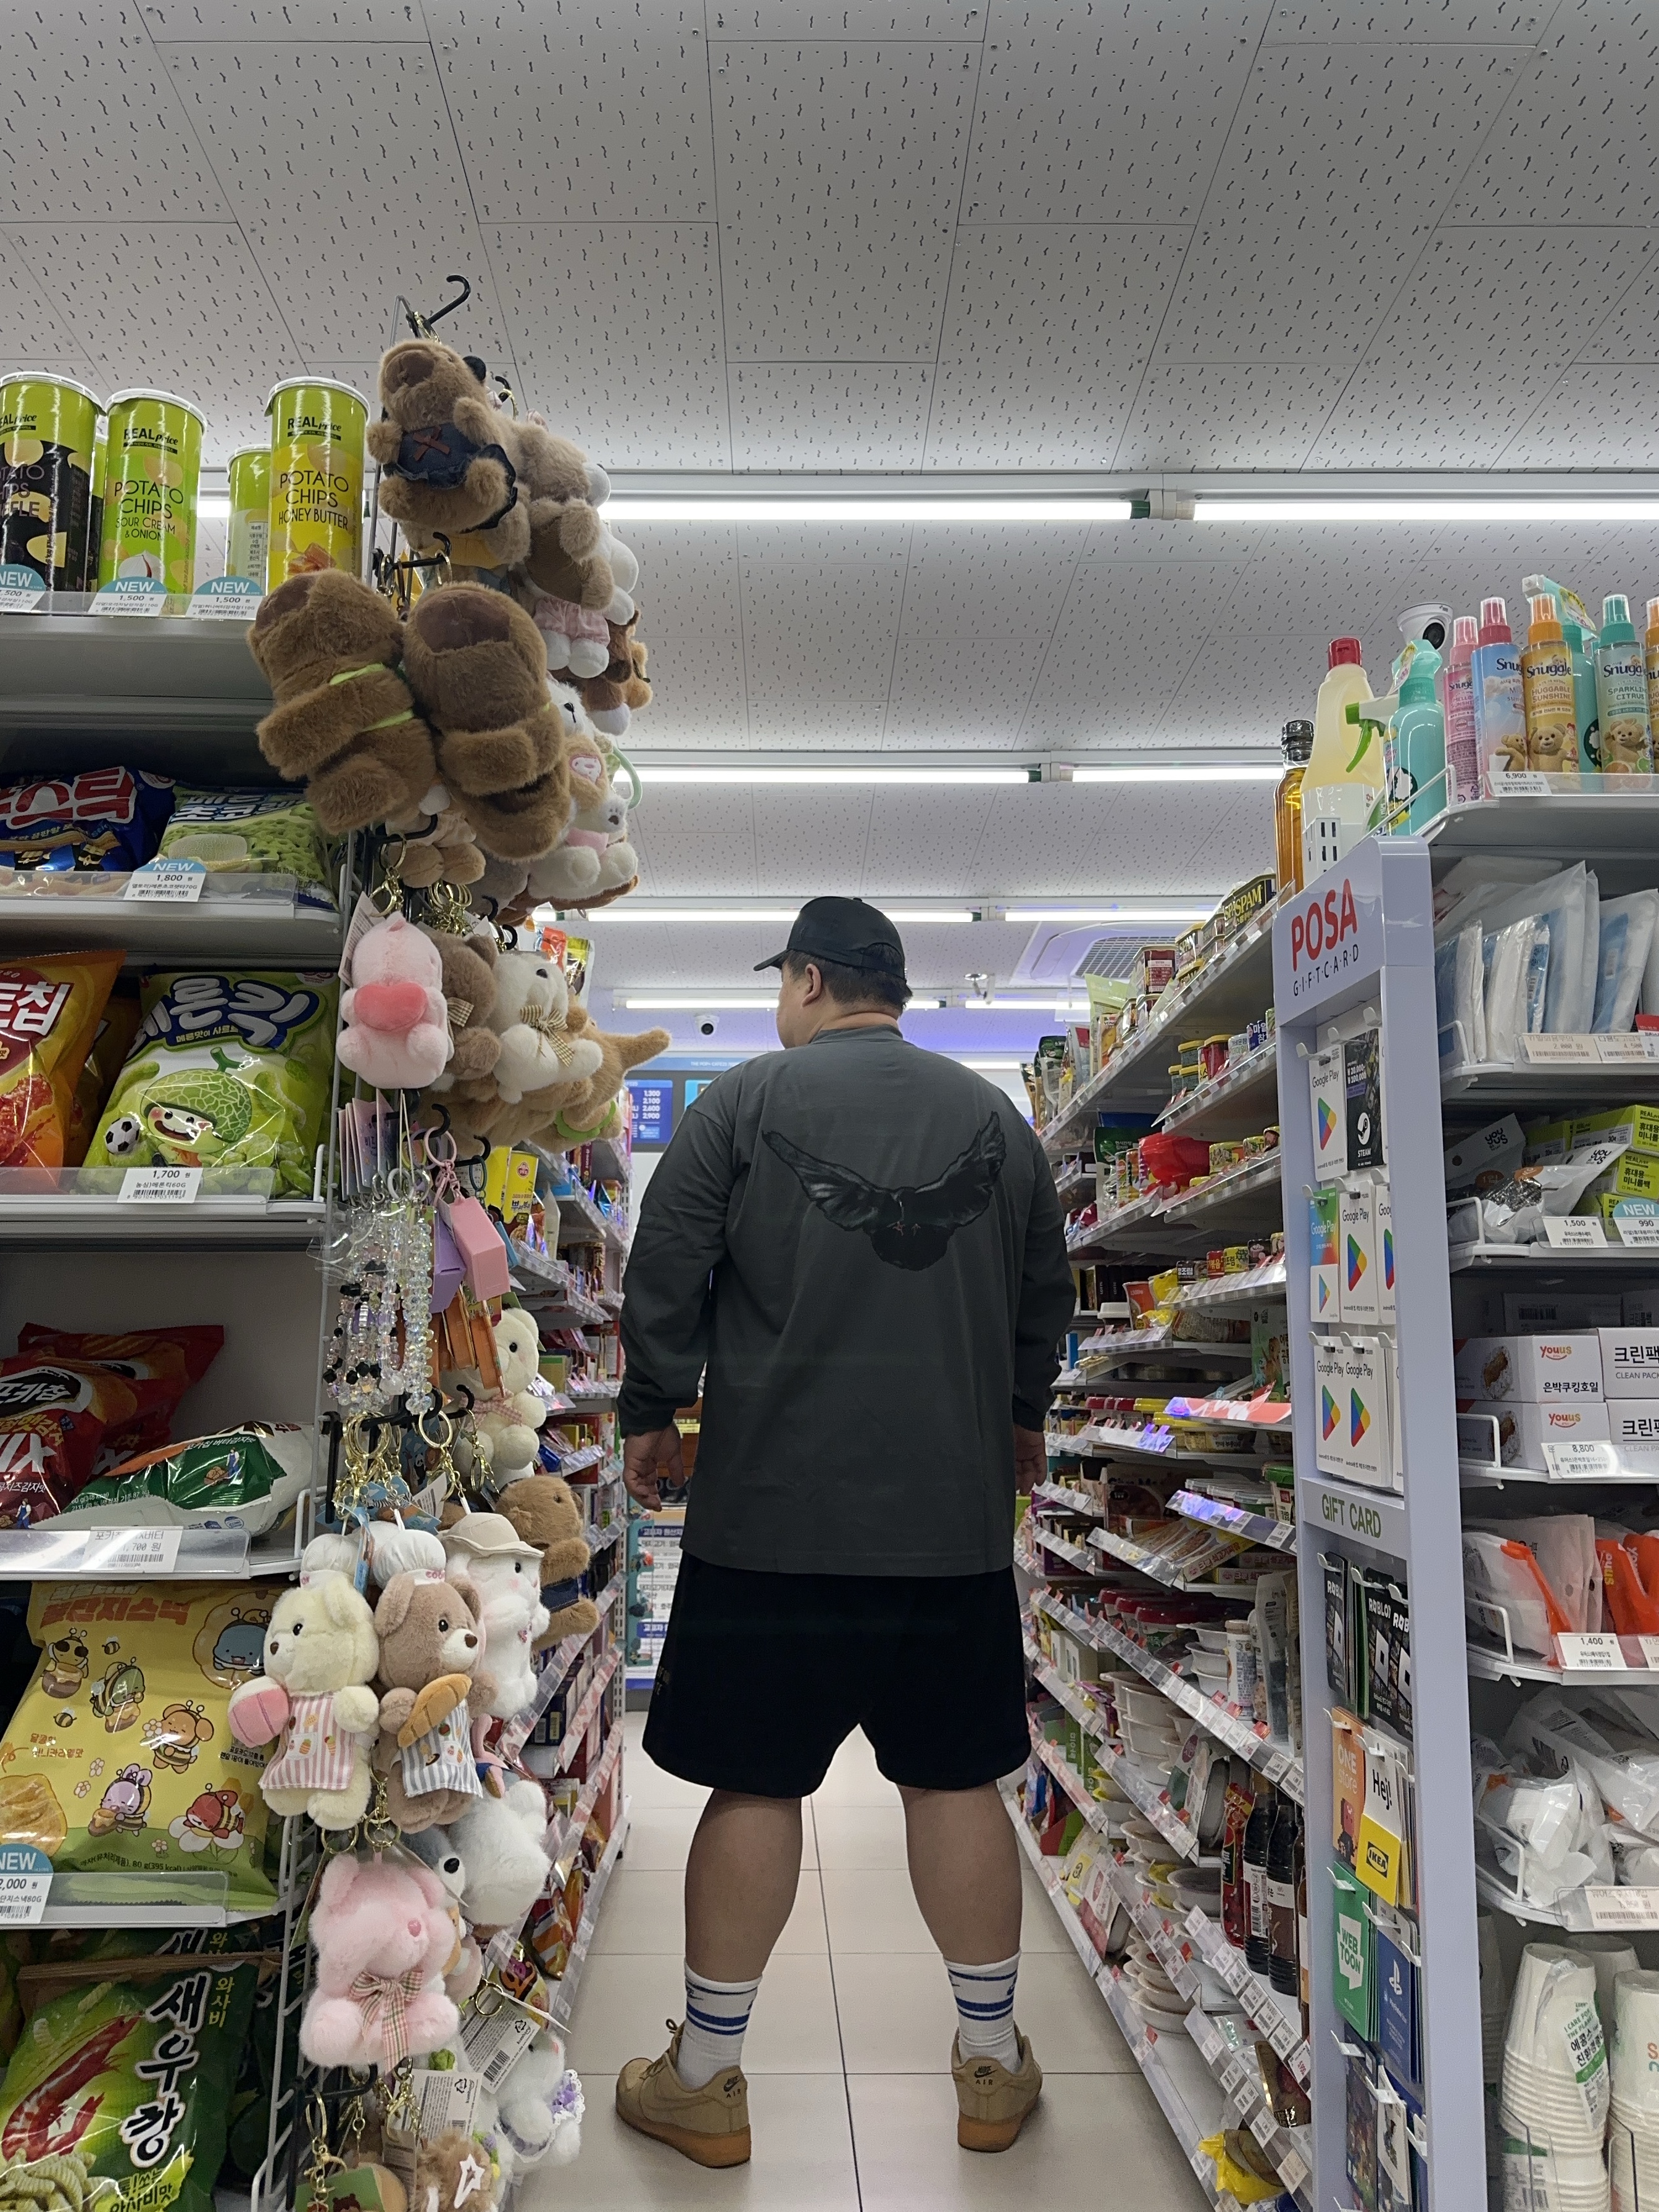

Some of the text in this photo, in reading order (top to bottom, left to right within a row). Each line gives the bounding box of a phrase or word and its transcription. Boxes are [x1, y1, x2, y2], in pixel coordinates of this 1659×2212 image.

[287, 417, 318, 430] REAL
[124, 428, 153, 439] REAL
[280, 470, 349, 493] POTATO
[115, 480, 185, 504] POTATO
[285, 489, 339, 508] CHIPS
[120, 498, 173, 519] CHIPS
[115, 517, 176, 535] SOUR CREAM
[278, 508, 349, 531] HONEY BUTTER
[0, 572, 32, 587] NEW
[115, 581, 155, 592] NEW
[210, 581, 250, 594] NEW
[1496, 658, 1523, 675] Snug
[1526, 659, 1572, 679] Snuggle
[1449, 681, 1473, 692] Snugg
[1532, 686, 1571, 697] HUGGABLE
[1532, 692, 1572, 704] SUNSHINE
[152, 863, 195, 871] NEW
[1236, 884, 1262, 917] SPAM
[1291, 878, 1357, 973] POSA
[1312, 1069, 1340, 1088] Google Play
[1358, 1148, 1372, 1157] STEAM
[152, 1170, 181, 1180] 1,700
[1624, 1167, 1645, 1178] 휴대용
[1342, 1208, 1370, 1224] Google Play
[1379, 1203, 1392, 1218] Goog
[1623, 1204, 1655, 1216] NEW
[1311, 1220, 1336, 1237] Google Play
[1564, 1220, 1586, 1228] 1,500
[1540, 1345, 1572, 1358] youus
[1317, 1360, 1344, 1378] Google Play
[1345, 1362, 1373, 1380] Google Play
[1542, 1381, 1599, 1393] 은박쿠킹호일
[1548, 1412, 1581, 1426] youus
[1572, 1444, 1595, 1453] 8,800
[1321, 1493, 1382, 1539] GIFT CARD
[1393, 1611, 1409, 1634] ROB
[1581, 1637, 1603, 1646] 1,400
[1337, 1744, 1357, 1776] ONE
[1338, 1768, 1358, 1795] store
[1372, 1768, 1393, 1811] Hej!
[0, 1852, 37, 1871] NEW
[1368, 1847, 1387, 1870] IKEA
[1341, 1927, 1358, 1955] WEB
[1339, 1941, 1361, 1975] TOON
[209, 1976, 235, 2028] 와사비
[123, 1974, 207, 2161] 새우깡
[726, 2089, 741, 2098] AIR
